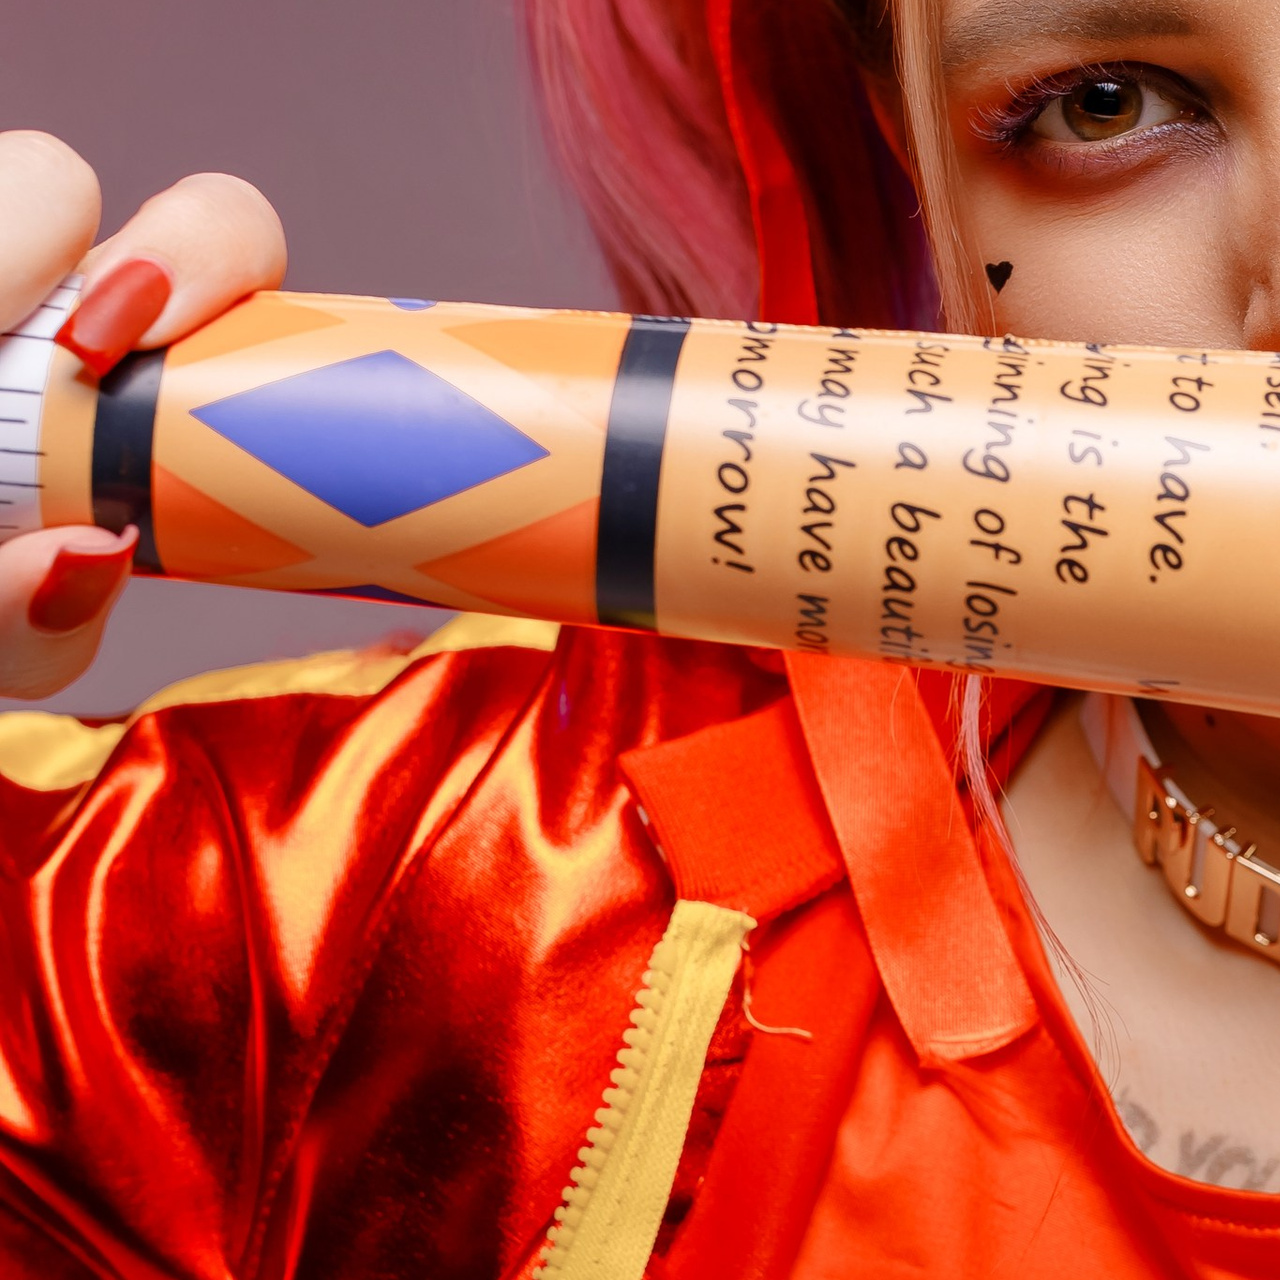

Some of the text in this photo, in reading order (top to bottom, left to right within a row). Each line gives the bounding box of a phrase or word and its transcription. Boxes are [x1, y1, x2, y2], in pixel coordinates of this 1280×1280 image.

[797, 347, 860, 428] may
[905, 341, 955, 415] such
[1169, 375, 1214, 412] to
[894, 441, 928, 470] a
[1068, 429, 1119, 467] is
[798, 452, 857, 573] have
[970, 508, 1022, 565] of
[1055, 493, 1110, 585] the
[1148, 435, 1211, 586] have.
